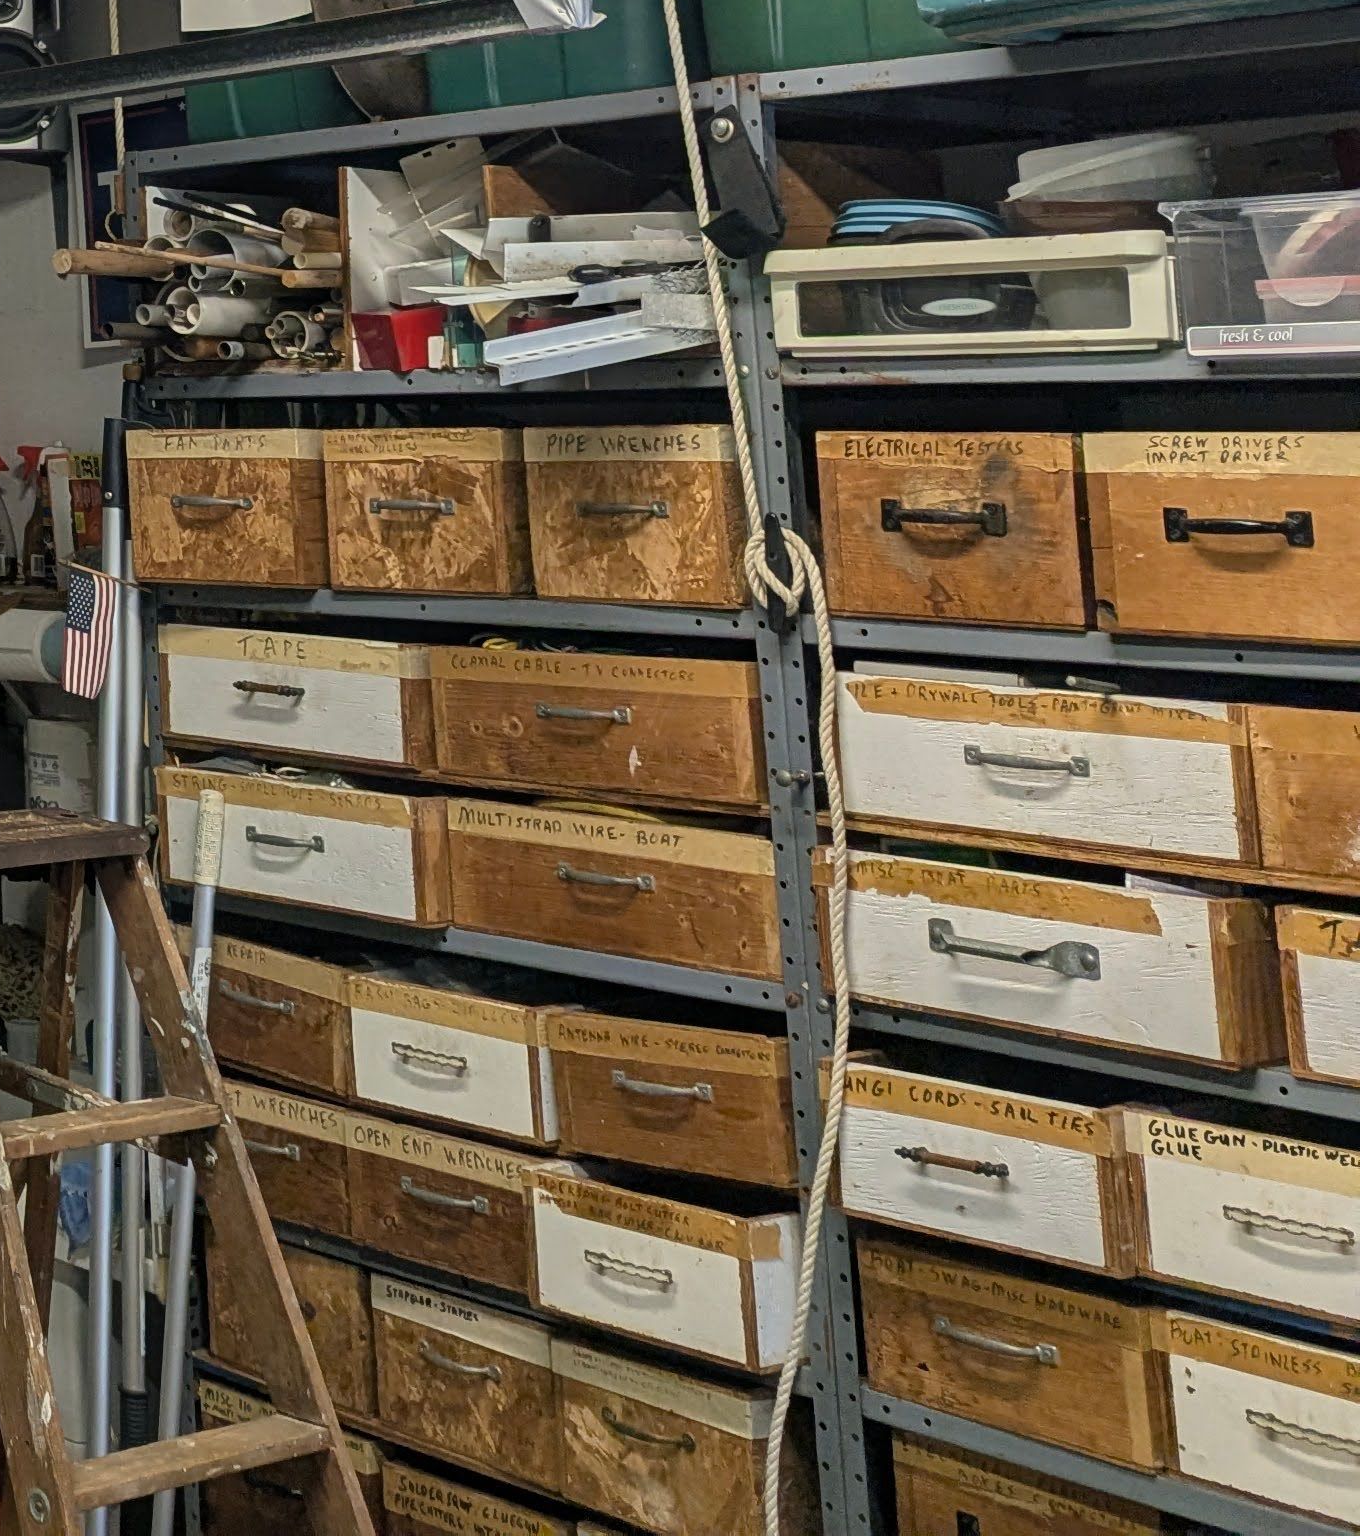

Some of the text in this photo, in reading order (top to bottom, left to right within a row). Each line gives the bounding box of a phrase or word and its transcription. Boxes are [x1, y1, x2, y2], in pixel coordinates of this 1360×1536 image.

[1218, 326, 1294, 345] fresh & cool
[547, 434, 701, 456] PIPE WRENCHES
[844, 437, 1024, 458] ELECTRICAL TESTERS
[1148, 435, 1306, 450] SCREW DRIVERS
[1145, 449, 1291, 464] IMPACT DRIVER
[237, 635, 306, 660] TAPE
[515, 657, 561, 675] CABLE
[582, 663, 602, 677] TV
[172, 773, 228, 791] STRING
[458, 806, 563, 834] MULTISTRAD
[636, 829, 684, 848] BOAT
[252, 1094, 339, 1129] WRENCHES
[909, 1085, 967, 1108] CORDS
[989, 1100, 1039, 1124] SAIL
[1047, 1110, 1095, 1136] TIES
[1148, 1119, 1199, 1143] GLUE
[1203, 1129, 1246, 1148] GUN
[1262, 1138, 1320, 1160] PLASTIC
[1150, 1138, 1203, 1161] GLUE
[353, 1124, 524, 1179] OPEN END WRENCHES
